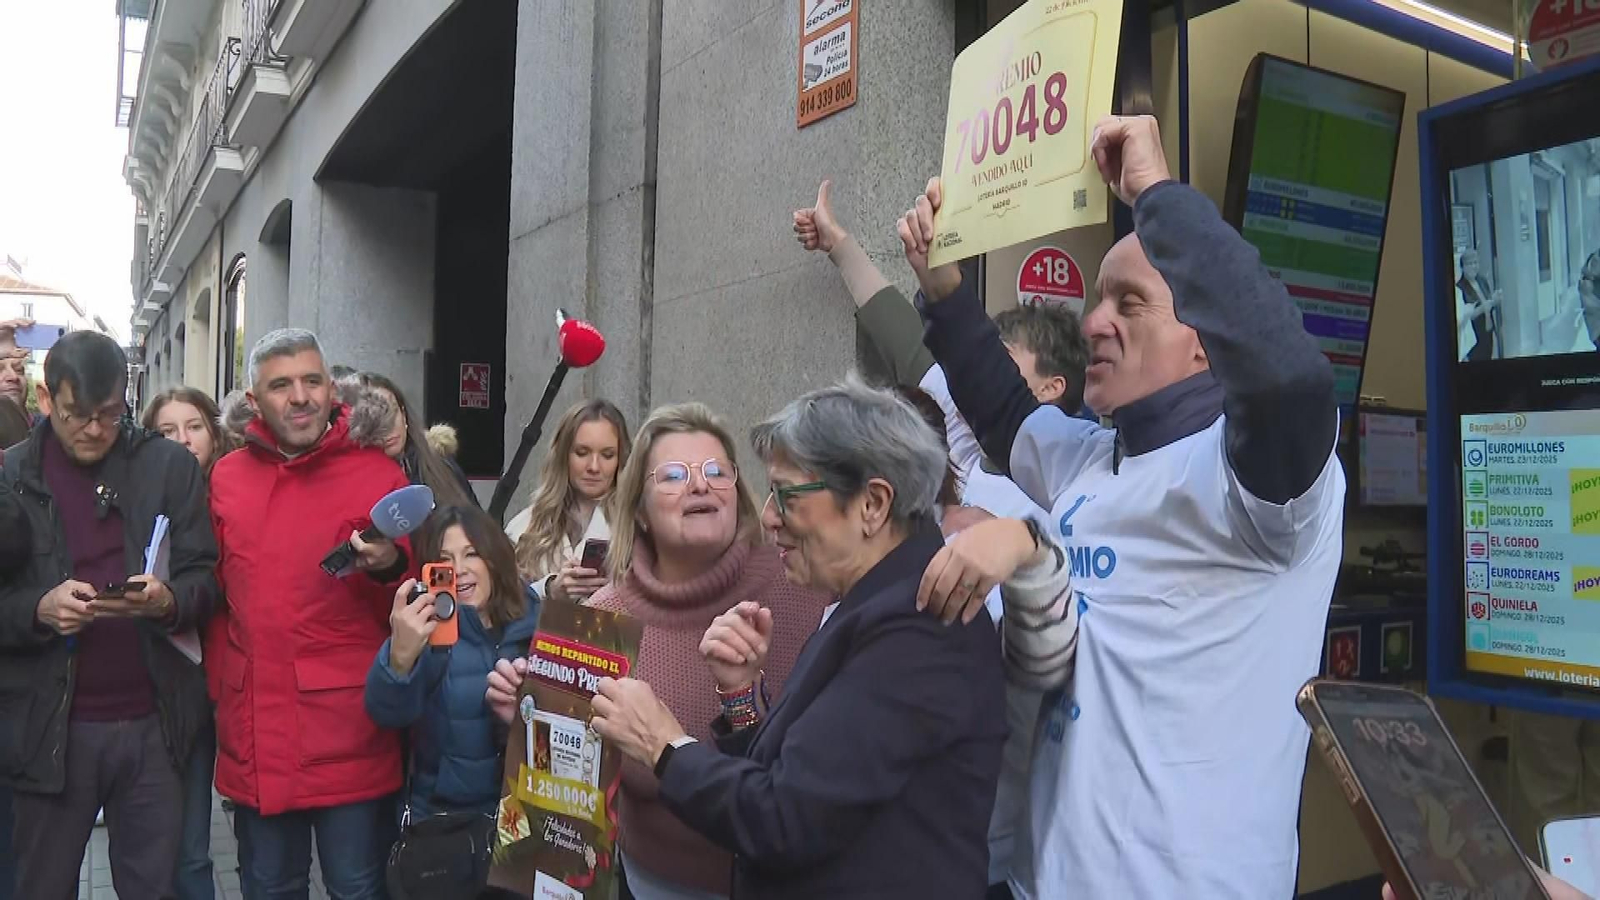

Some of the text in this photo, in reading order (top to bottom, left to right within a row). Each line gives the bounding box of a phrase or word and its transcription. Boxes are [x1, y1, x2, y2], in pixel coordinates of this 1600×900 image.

[814, 31, 846, 56] alarma
[800, 78, 852, 117] 914 339 800
[955, 71, 1067, 174] 70048
[1032, 256, 1070, 285] +18
[1488, 441, 1565, 454] EUROMILLONES
[1489, 474, 1540, 485] PRIMITIVA
[388, 502, 410, 531] tve
[1490, 505, 1544, 517] BONOLOTO
[1490, 536, 1539, 548] EL GORDO
[1066, 546, 1117, 579] MIO
[1491, 568, 1560, 582] EURODREAMS
[1491, 598, 1537, 612] QUINIELA
[561, 646, 608, 669] REPARTIDO
[609, 661, 620, 674] EL
[577, 667, 600, 694] PRE
[553, 731, 581, 748] 70048
[1353, 717, 1428, 746] 10:33
